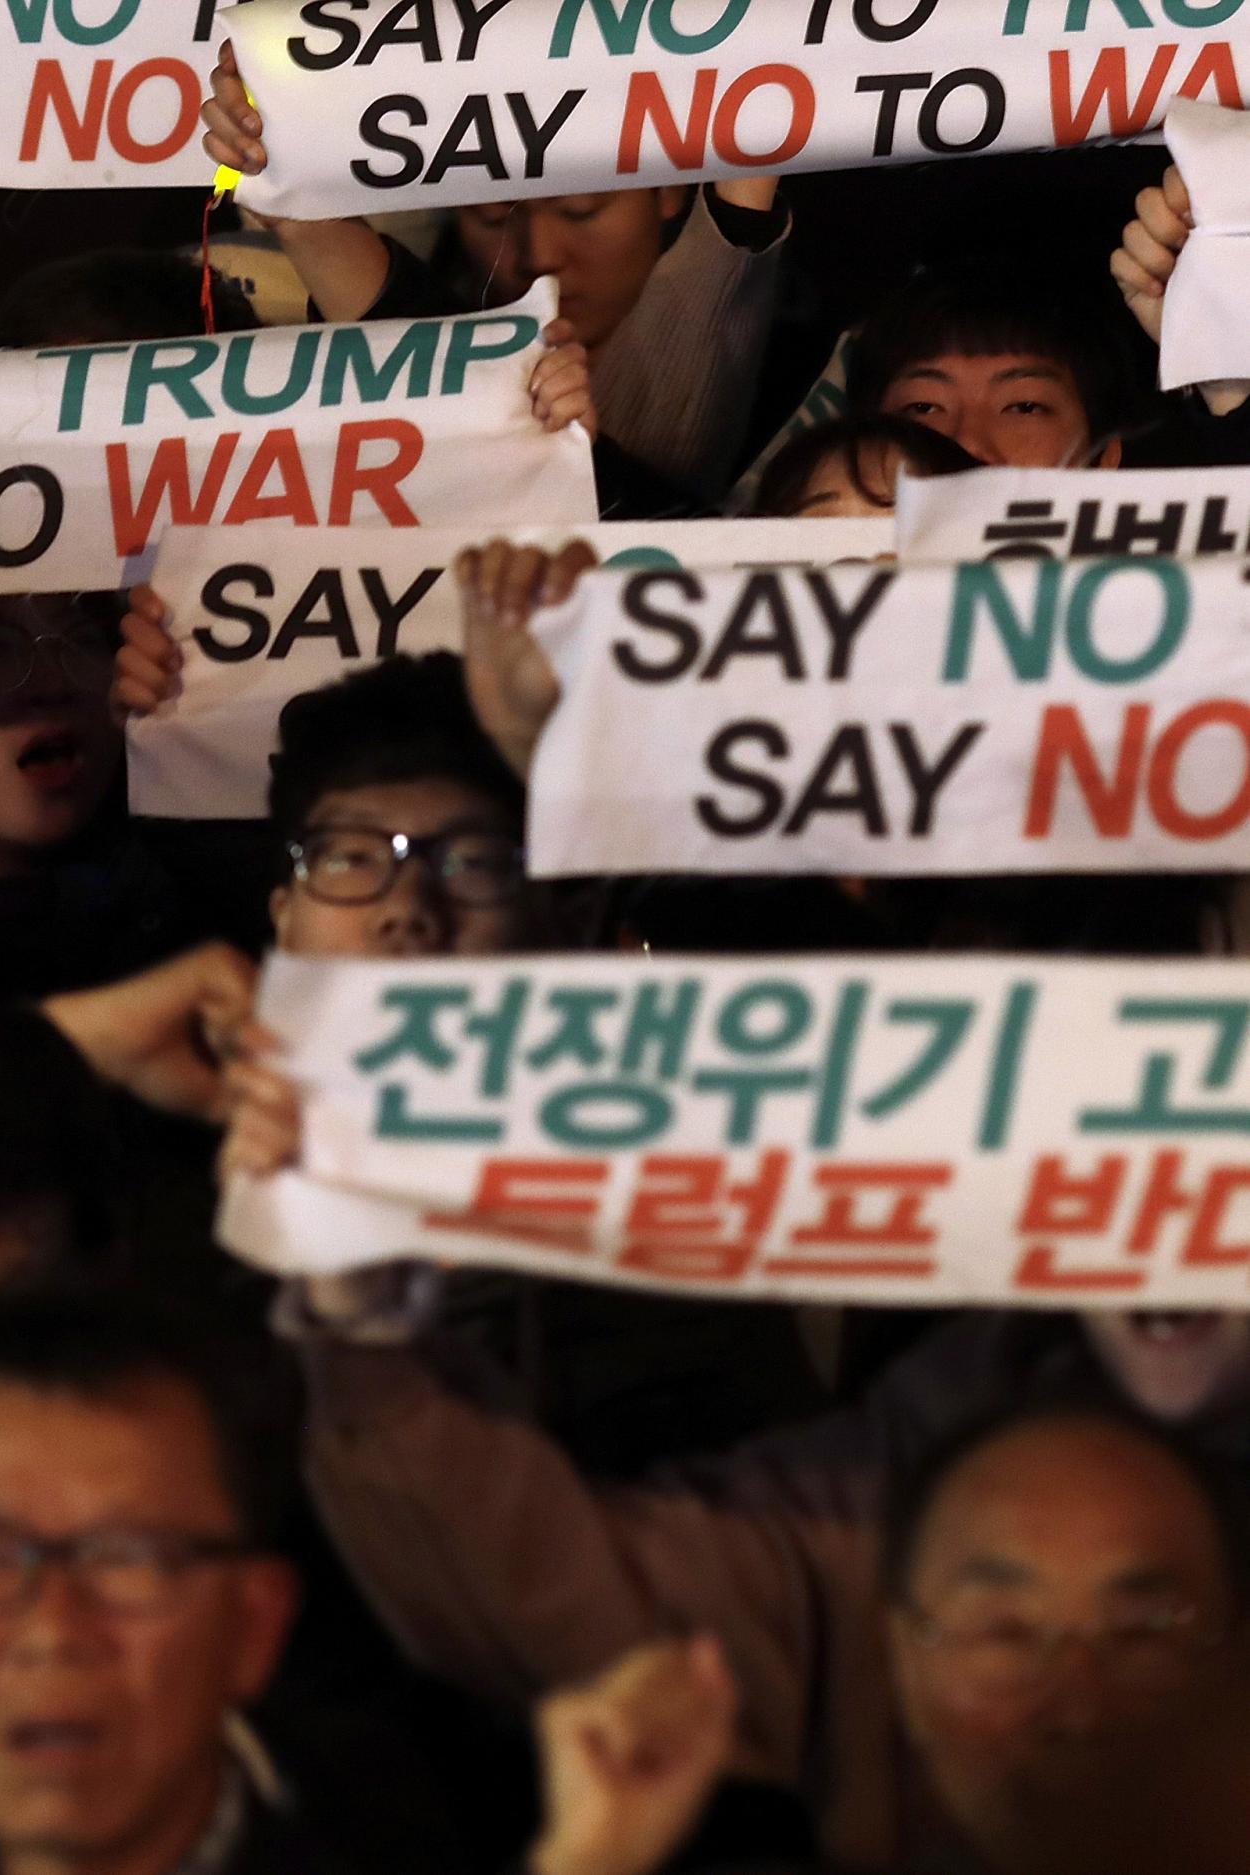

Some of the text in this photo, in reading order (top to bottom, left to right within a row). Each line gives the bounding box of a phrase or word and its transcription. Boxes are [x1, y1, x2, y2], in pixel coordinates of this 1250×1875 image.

[286, 0, 514, 72] SAY
[18, 56, 202, 165] NO
[350, 89, 588, 189] SAY
[615, 61, 816, 175] NO
[855, 67, 1006, 158] TO
[36, 314, 540, 433] TRUMP
[104, 417, 424, 558] WAR
[192, 562, 446, 663] SAY
[611, 557, 1192, 685] SAY NO
[694, 697, 1250, 843] SAY NO
[354, 976, 1250, 1154] 전쟁위기 고
